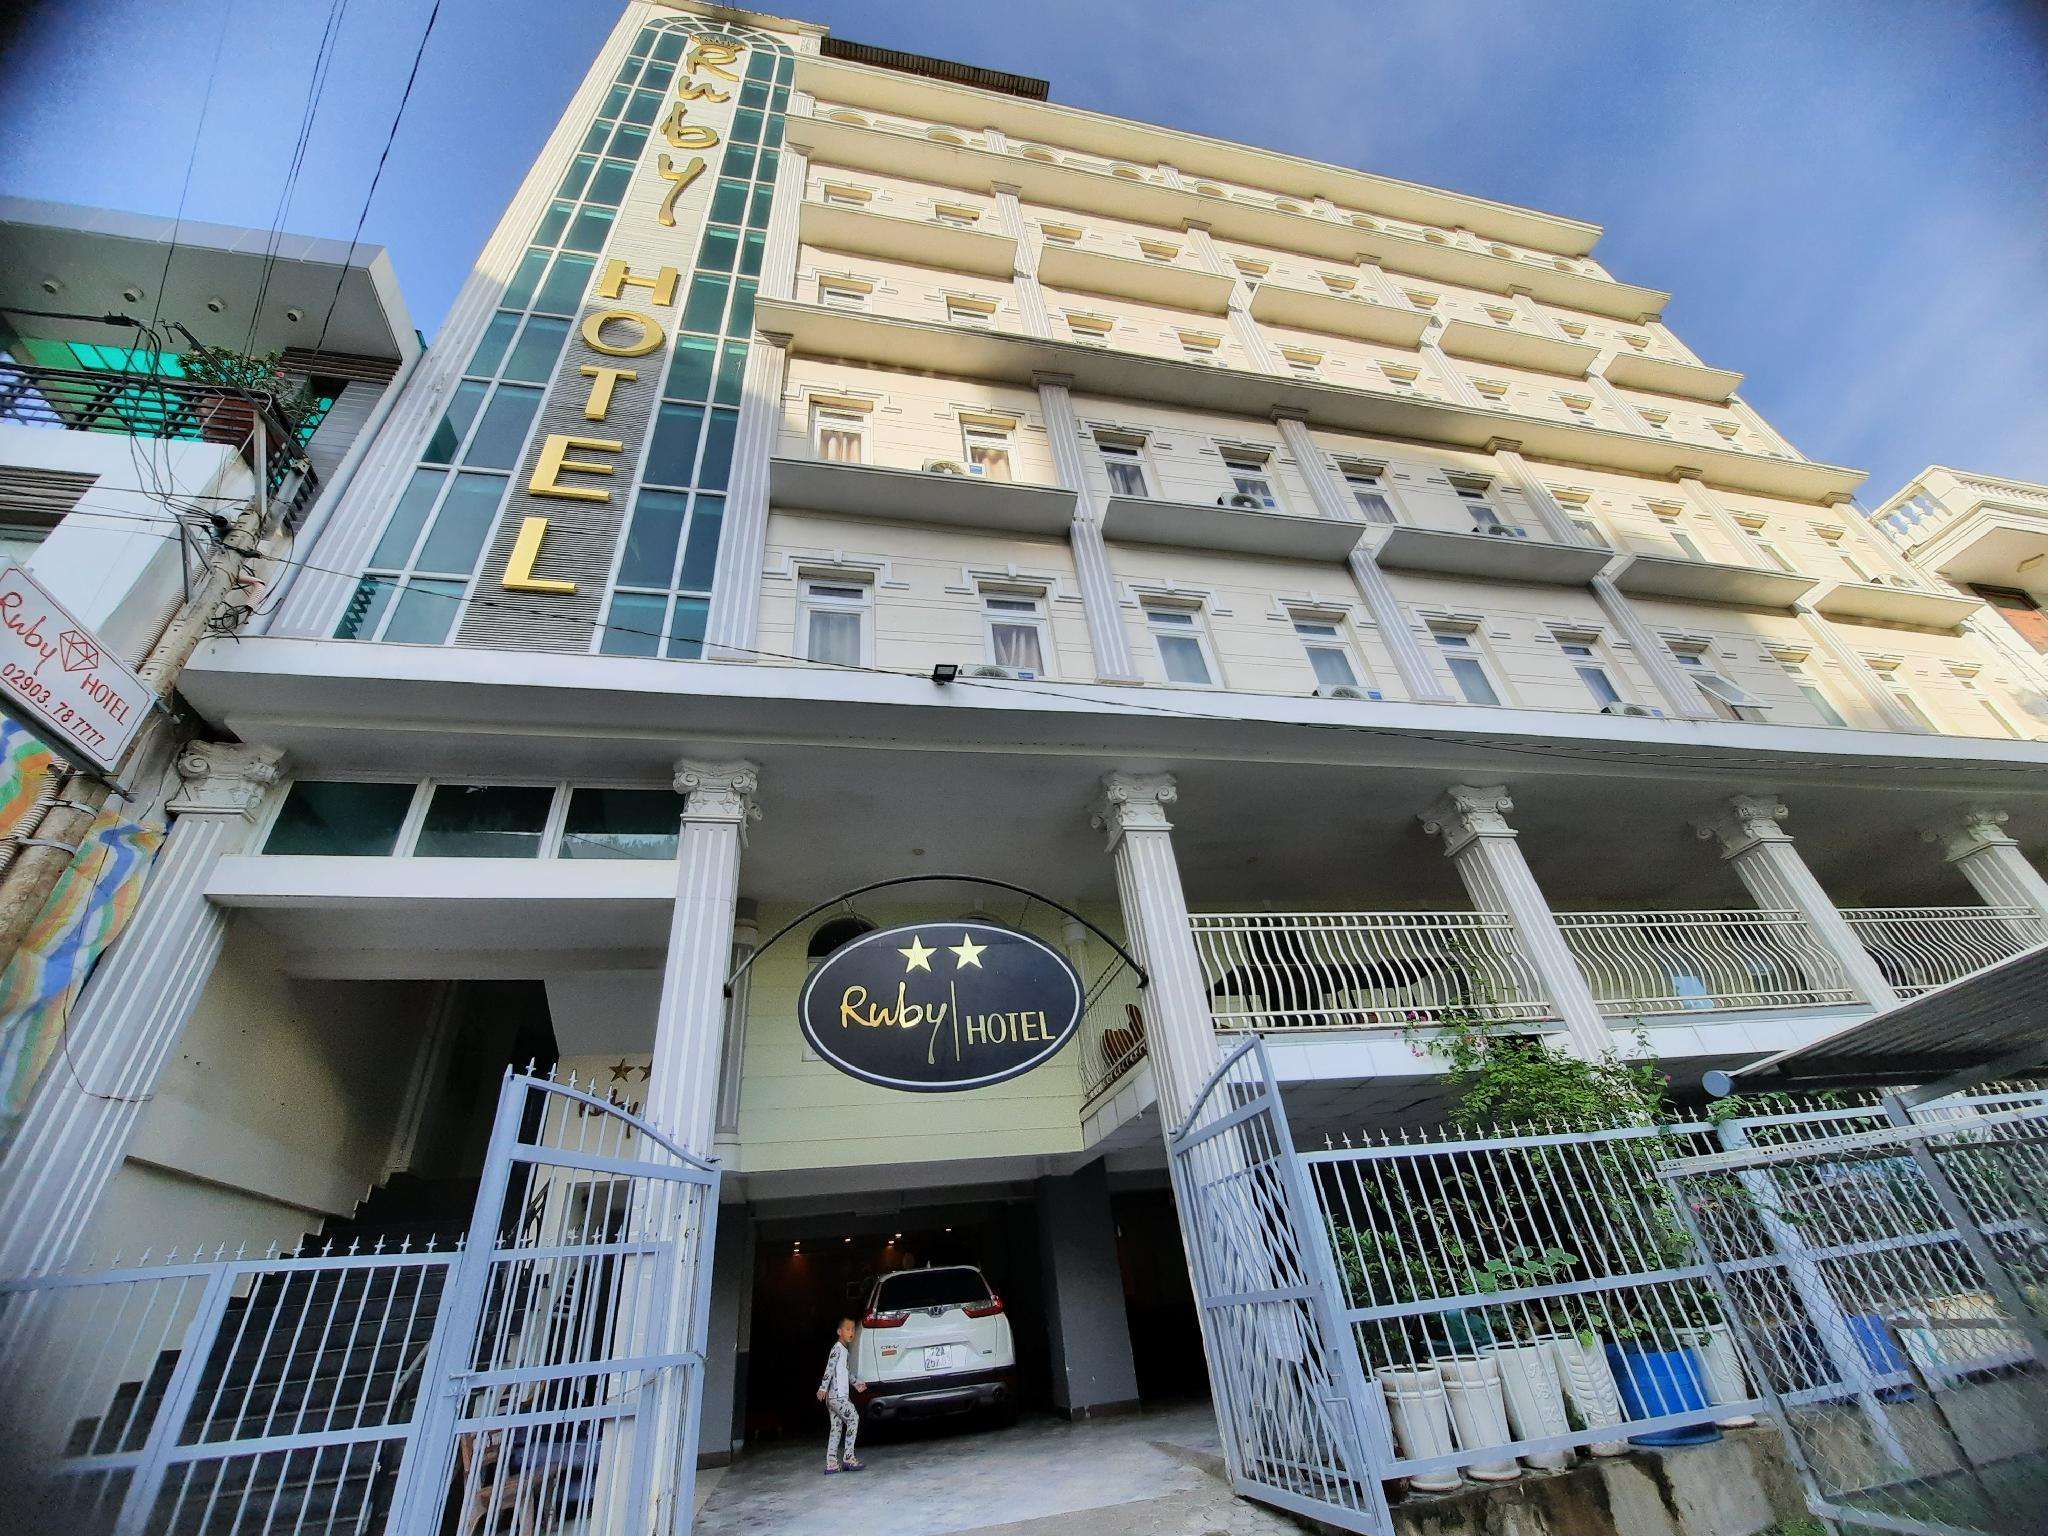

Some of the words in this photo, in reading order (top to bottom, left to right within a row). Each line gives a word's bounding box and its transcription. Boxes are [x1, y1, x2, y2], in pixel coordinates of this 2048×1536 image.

[502, 258, 681, 594] HOTEL
[0, 591, 57, 676] Ruby
[80, 673, 130, 726] HOTEL
[840, 981, 948, 1064] Ruby
[966, 1011, 1056, 1045] HOTEL
